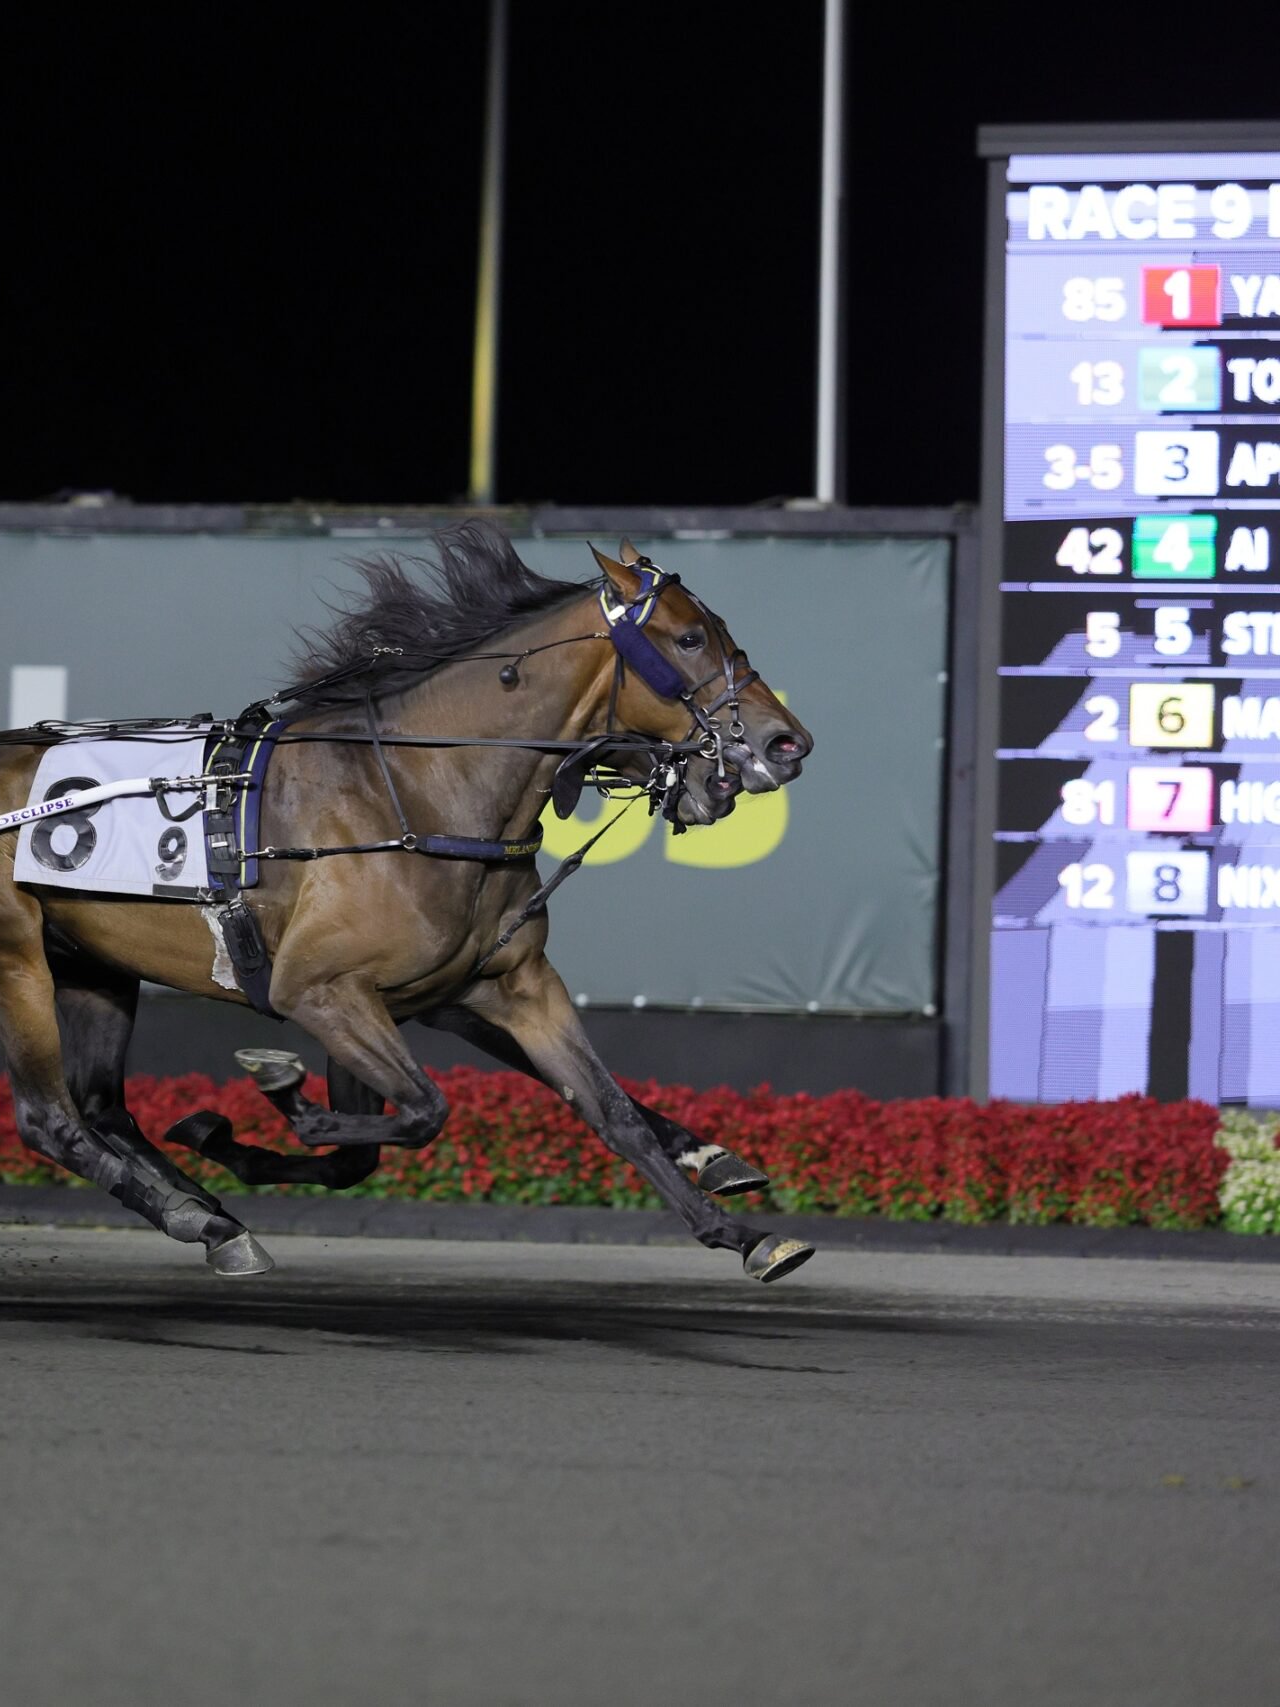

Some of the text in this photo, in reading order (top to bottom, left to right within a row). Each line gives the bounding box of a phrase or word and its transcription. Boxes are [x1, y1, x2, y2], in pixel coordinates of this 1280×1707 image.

[1028, 184, 1196, 240] RACE
[1210, 183, 1252, 239] 9
[1062, 277, 1126, 321] 85
[1163, 270, 1191, 320] 1
[1071, 361, 1124, 405] 13
[1158, 356, 1198, 403] 2
[1043, 444, 1123, 489] 3-5
[1164, 445, 1190, 481] 3
[1056, 522, 1269, 574] 42 4 AI
[1085, 612, 1120, 658] 5
[1154, 607, 1193, 655] 5
[1085, 695, 1119, 741] 2
[1159, 697, 1185, 733] 6
[31, 776, 103, 872] 8
[1061, 779, 1115, 825] 81
[1157, 781, 1182, 818] 7
[155, 826, 188, 881] 9
[1058, 863, 1115, 908] 12
[1155, 865, 1181, 902] 8
